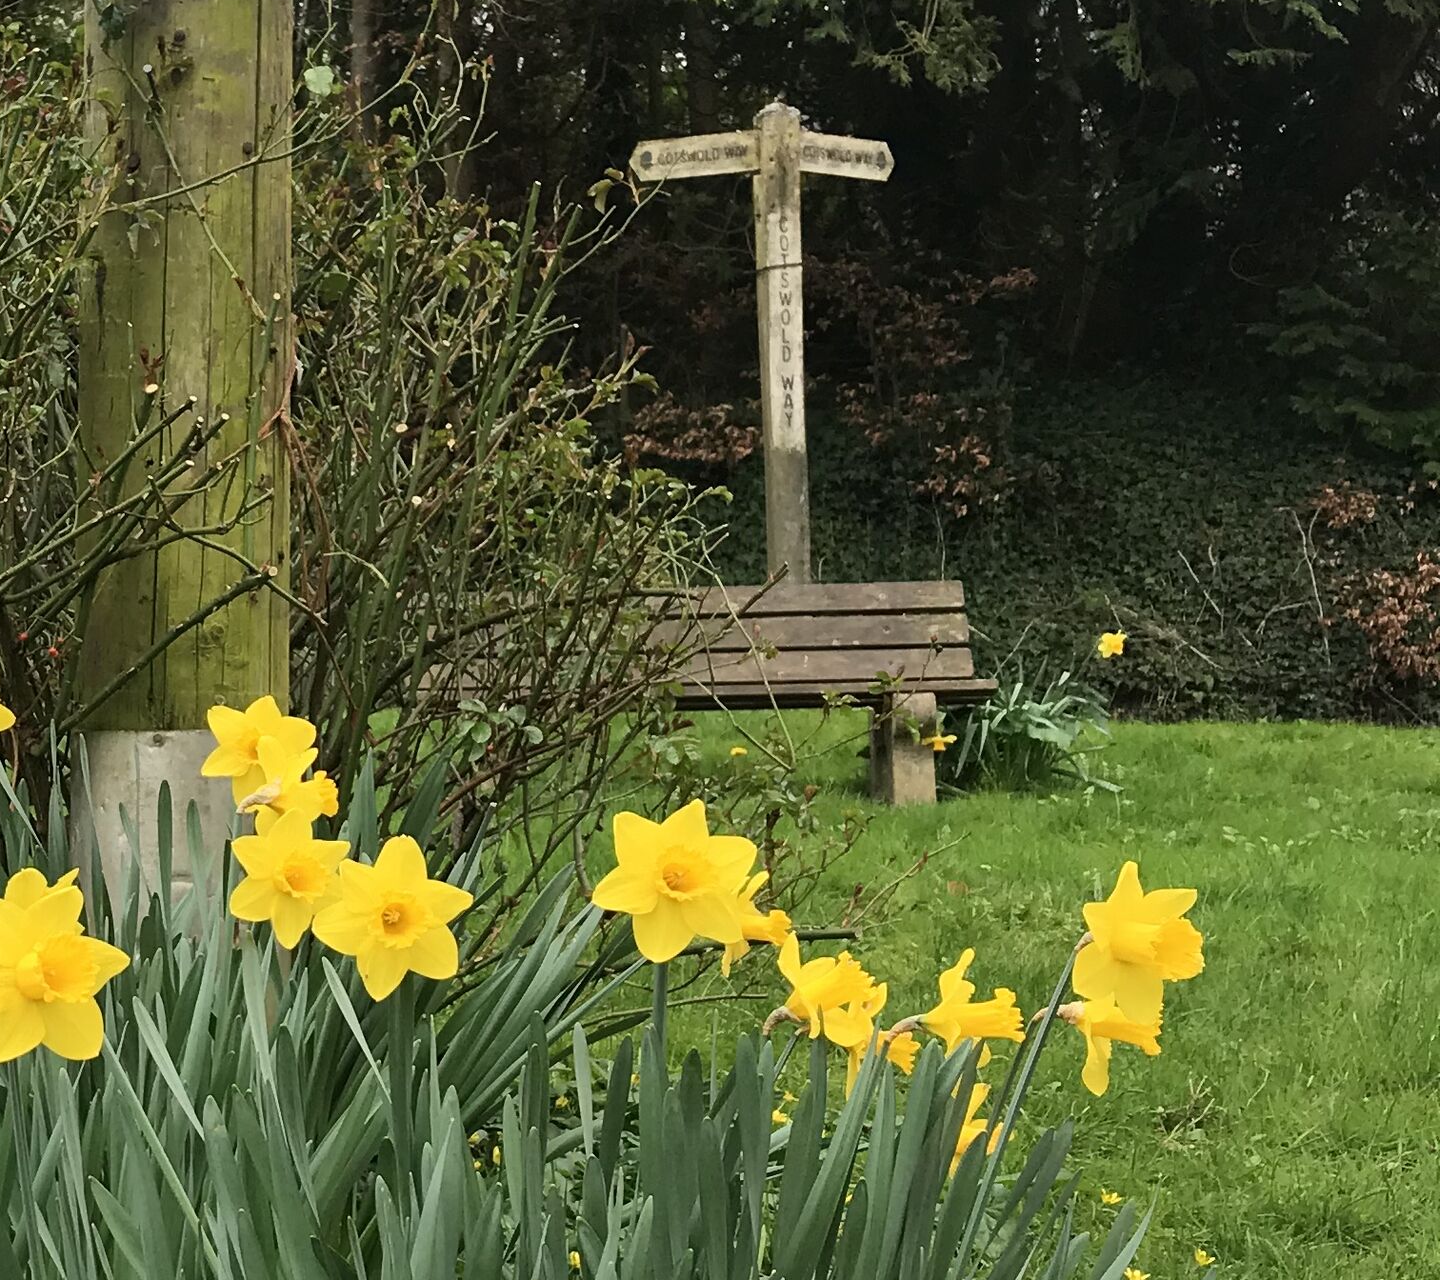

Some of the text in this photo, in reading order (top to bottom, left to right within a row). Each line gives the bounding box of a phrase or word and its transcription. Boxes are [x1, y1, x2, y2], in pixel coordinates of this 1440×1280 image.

[657, 147, 720, 166] COTSWOLD
[778, 215, 796, 426] COTSWOLD WAY
